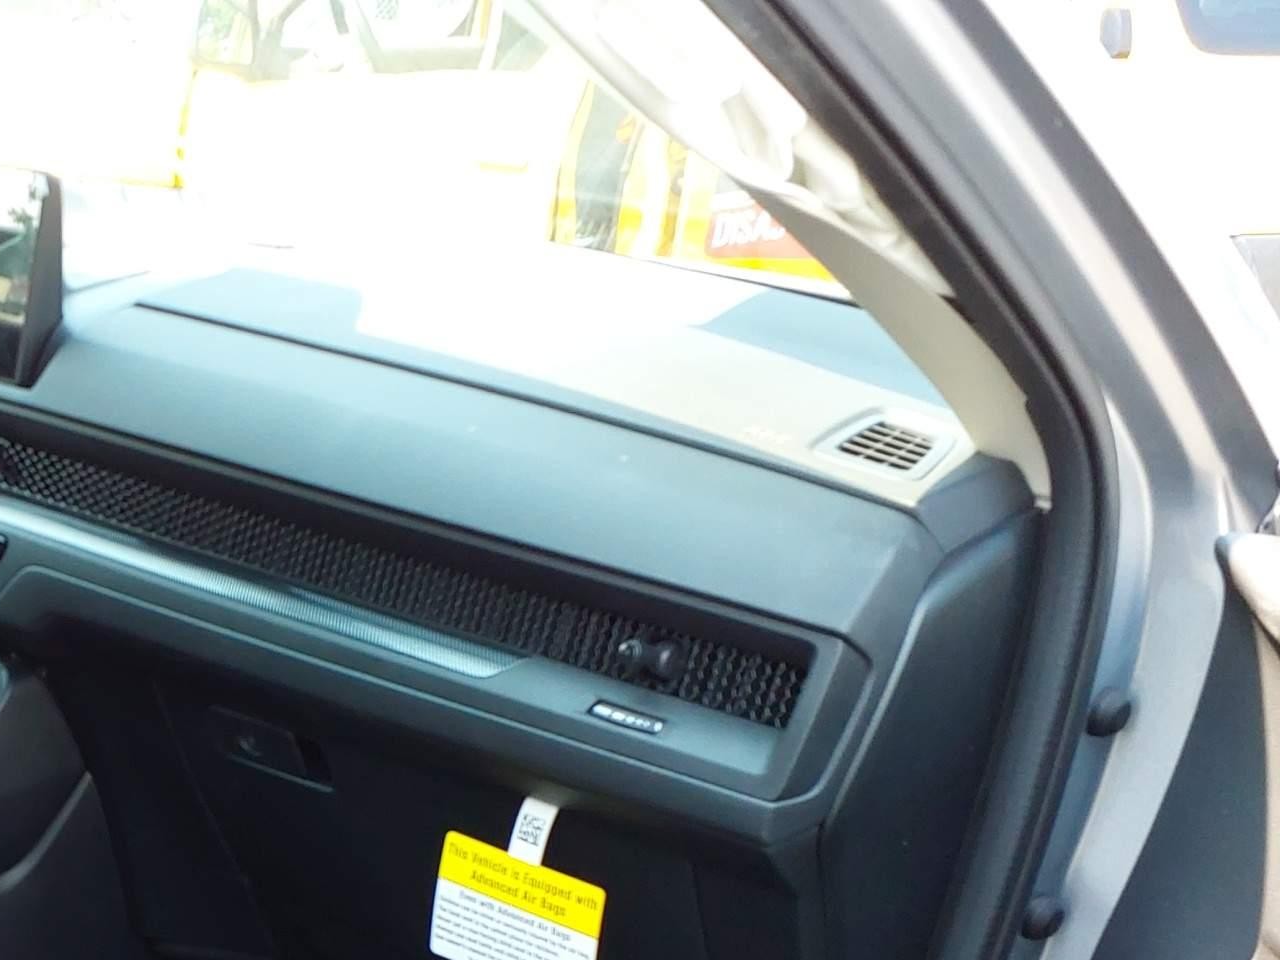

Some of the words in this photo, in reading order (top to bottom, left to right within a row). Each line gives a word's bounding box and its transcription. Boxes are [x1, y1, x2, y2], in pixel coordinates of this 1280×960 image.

[449, 843, 467, 860] This
[472, 850, 507, 876] Vehicle
[511, 865, 520, 880] is
[523, 872, 572, 901] Equipped
[576, 893, 598, 911] with
[471, 871, 519, 898] Advanced
[521, 891, 537, 905] Air
[540, 897, 567, 916] Bags
